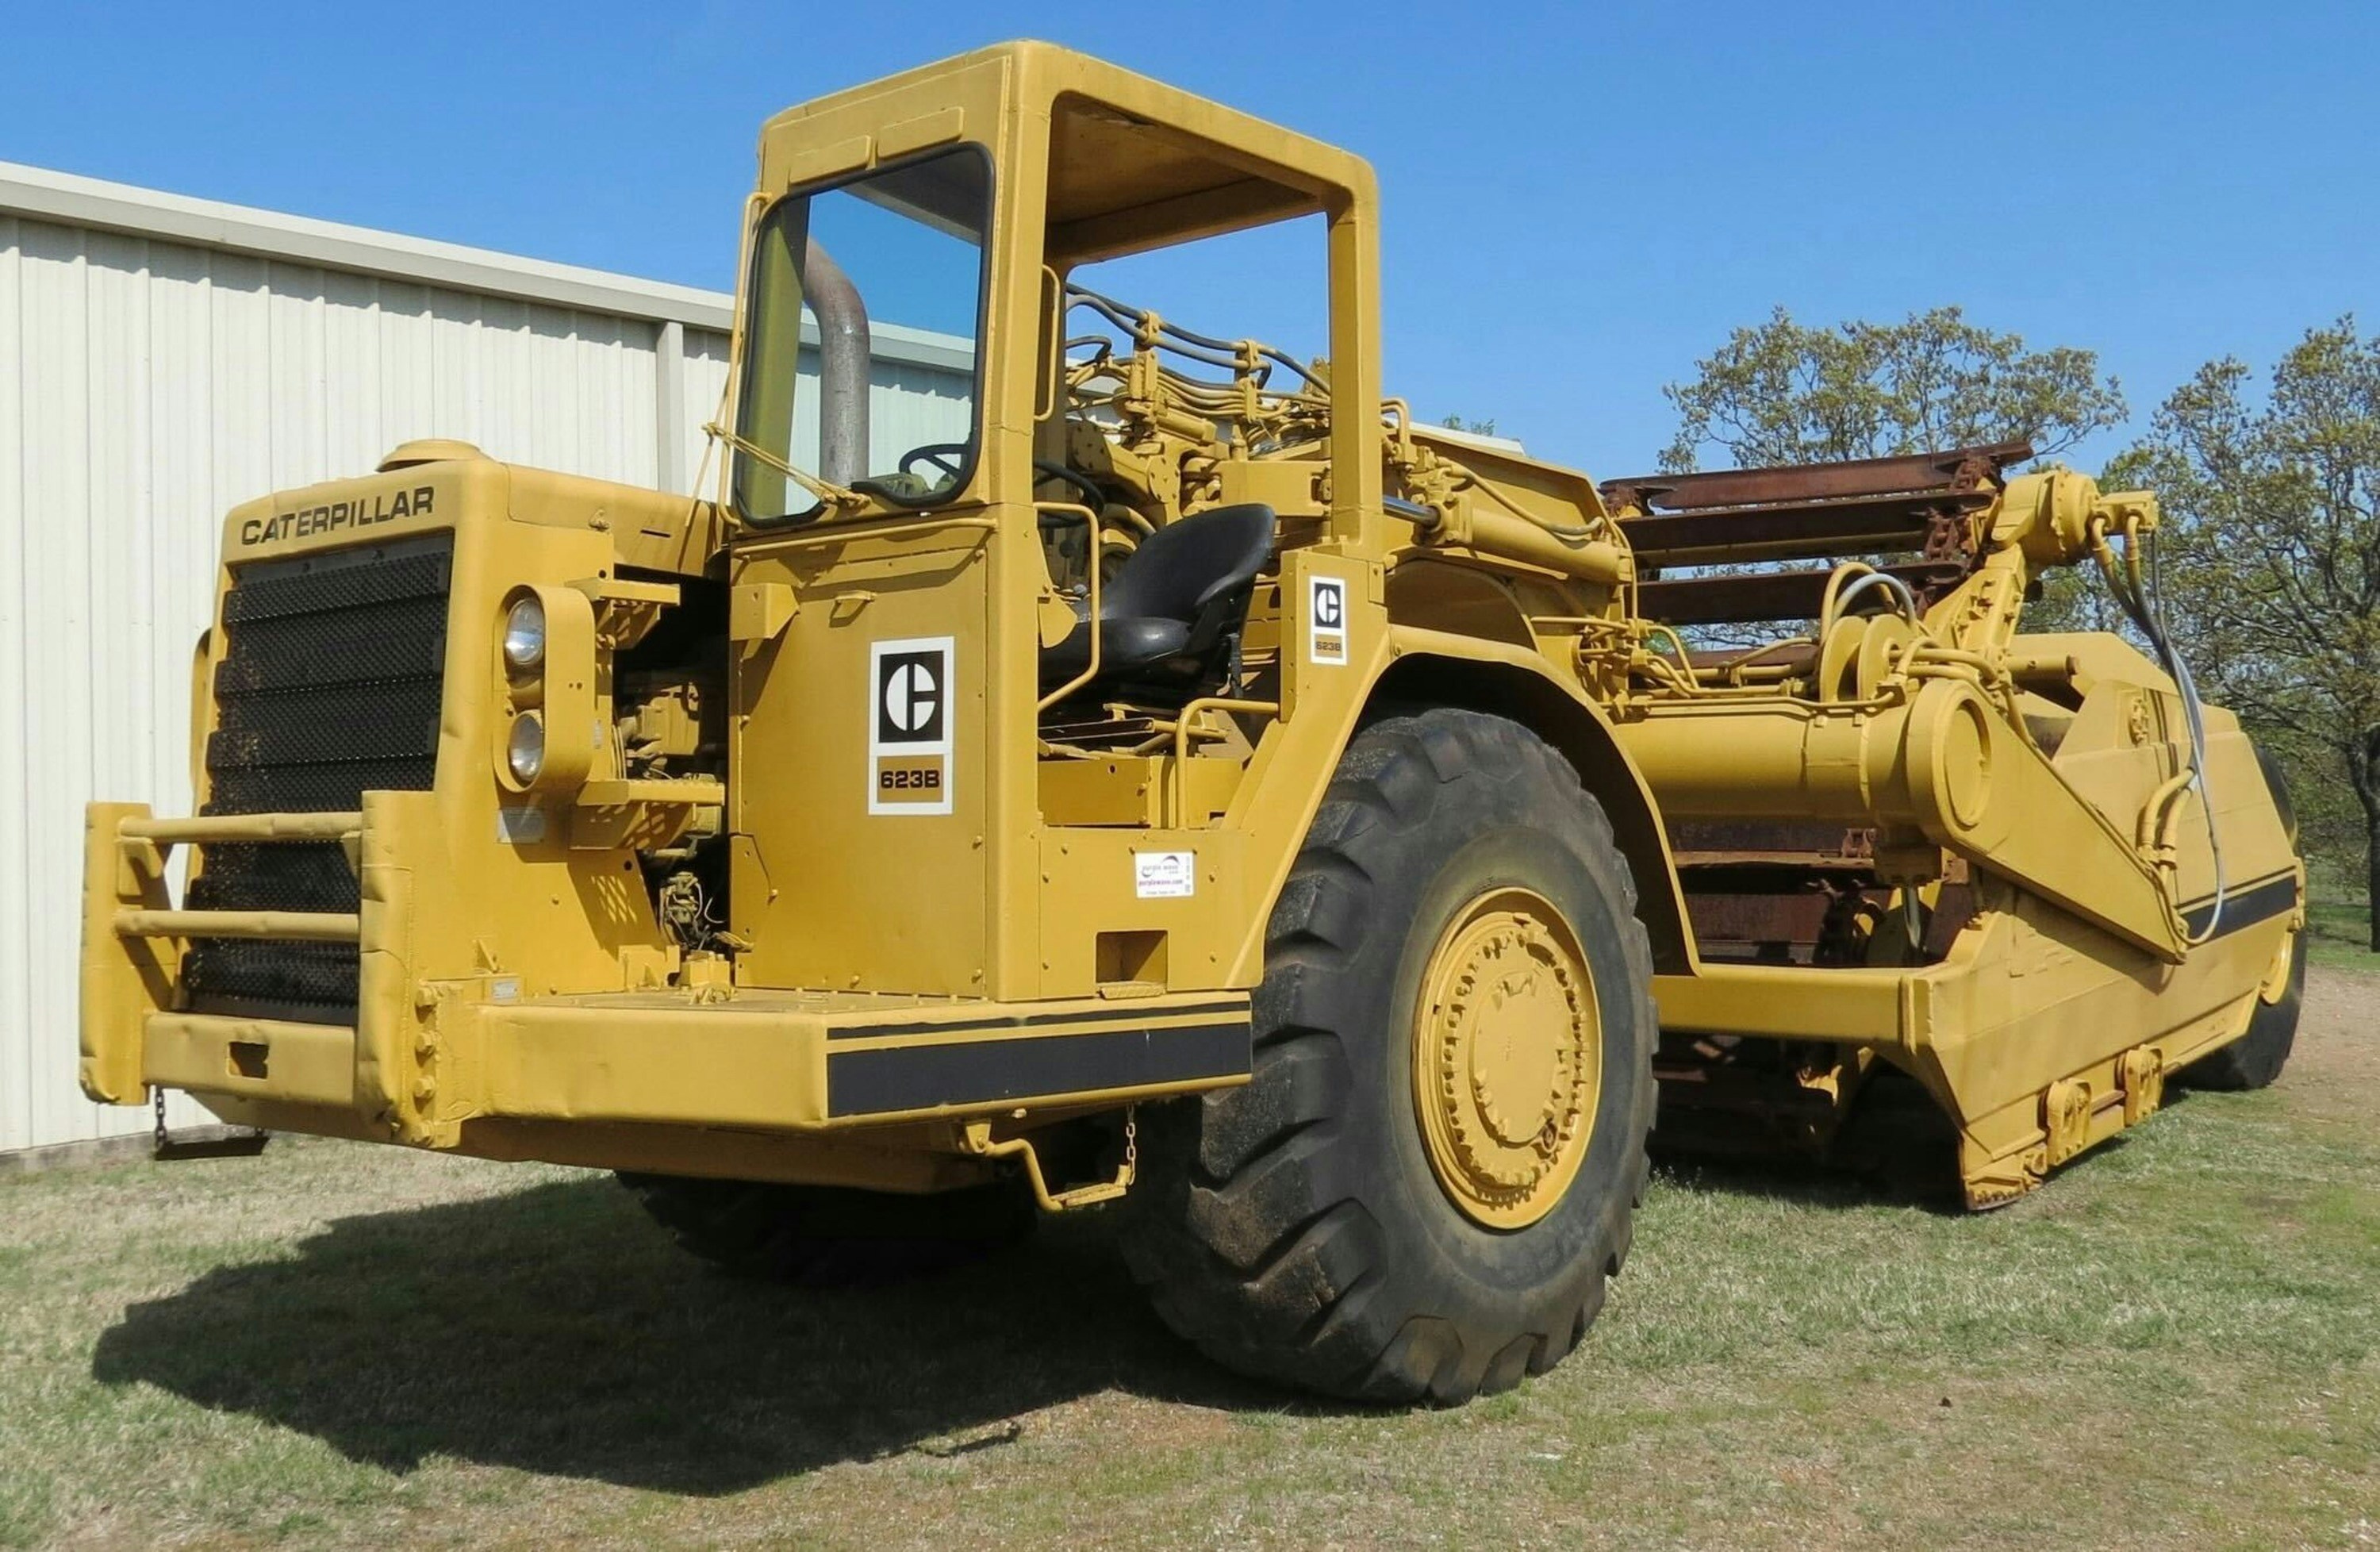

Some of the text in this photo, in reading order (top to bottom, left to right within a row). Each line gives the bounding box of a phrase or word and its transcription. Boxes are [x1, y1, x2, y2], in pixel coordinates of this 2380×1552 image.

[241, 486, 435, 545] CATERPILLAR
[1315, 641, 1342, 651] 623B
[881, 770, 940, 789] 623B
